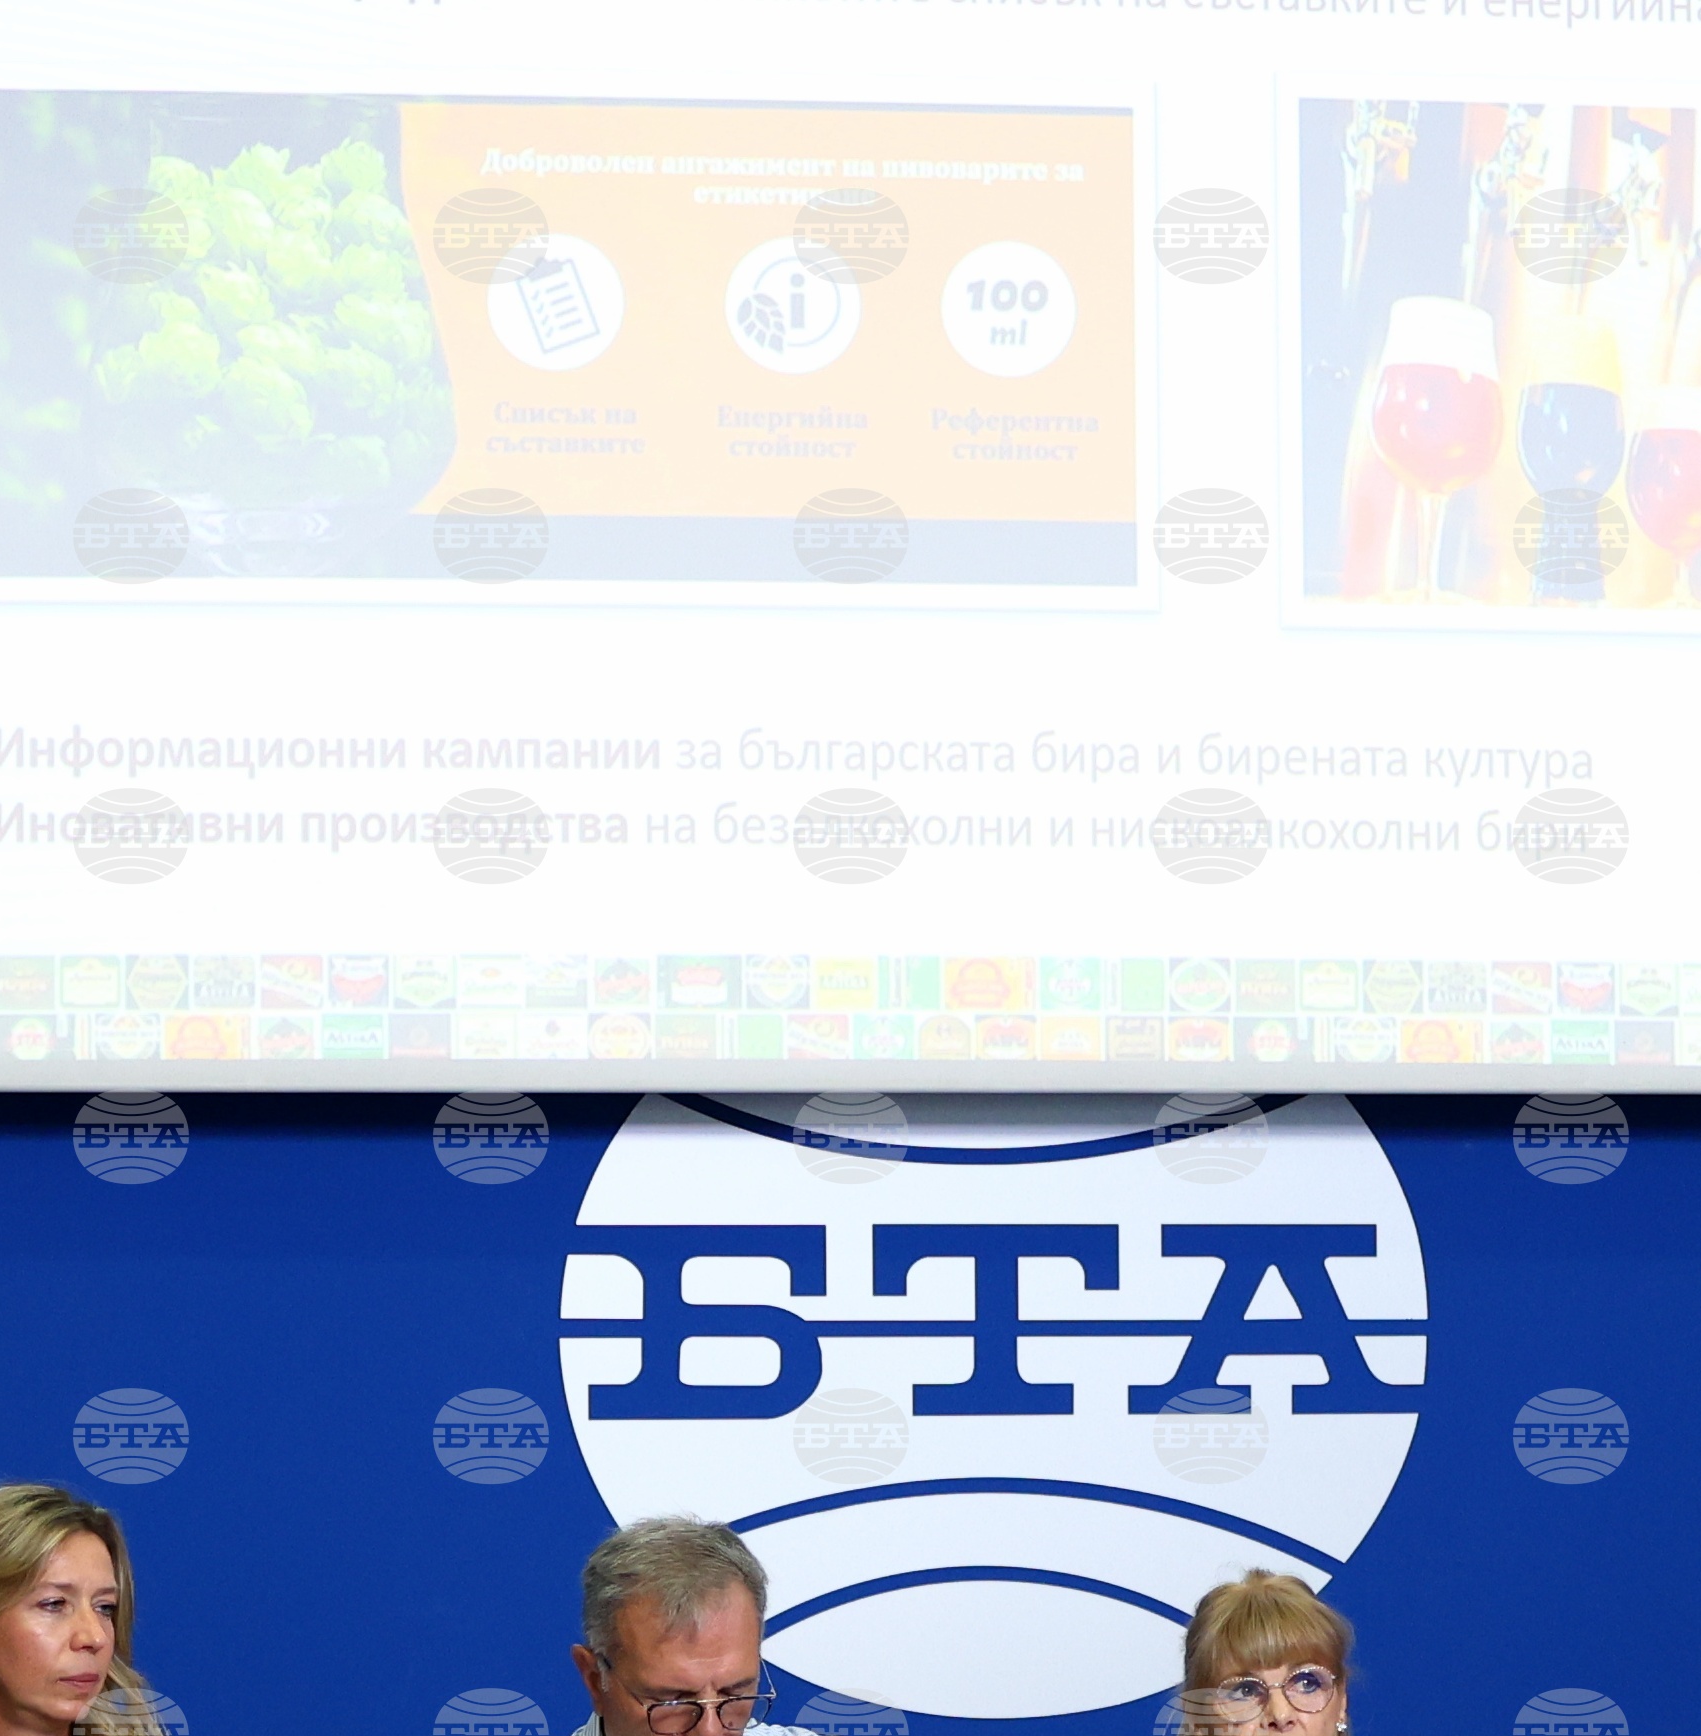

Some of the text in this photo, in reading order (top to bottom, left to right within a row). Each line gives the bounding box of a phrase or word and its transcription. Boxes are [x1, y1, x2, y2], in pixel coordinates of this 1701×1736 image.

[479, 148, 655, 178] Доброволен
[842, 158, 876, 178] на
[881, 159, 1049, 185] пивоварите
[1054, 163, 1085, 183] за
[966, 279, 1049, 313] 100
[989, 319, 1029, 347] ml
[493, 401, 638, 426] Списък на
[716, 404, 869, 436] Енергийна
[929, 406, 1100, 436] Референтна
[485, 435, 646, 455] съставките
[728, 434, 858, 459] стойност
[951, 435, 1079, 461] стойност
[423, 736, 661, 771] кампании
[676, 740, 722, 771] за
[739, 727, 1016, 783] българската
[1031, 730, 1142, 785] бира
[1157, 745, 1183, 774] и
[1197, 732, 1408, 785] бирената
[1425, 744, 1594, 789] култура
[300, 807, 629, 854] производства
[645, 815, 698, 845] на
[712, 802, 1033, 850] безалкохолни
[1049, 817, 1075, 848] и
[1090, 817, 1462, 852] нискоалкохолни
[1476, 810, 1589, 862] бири
[574, 1223, 1422, 1420] БТА
